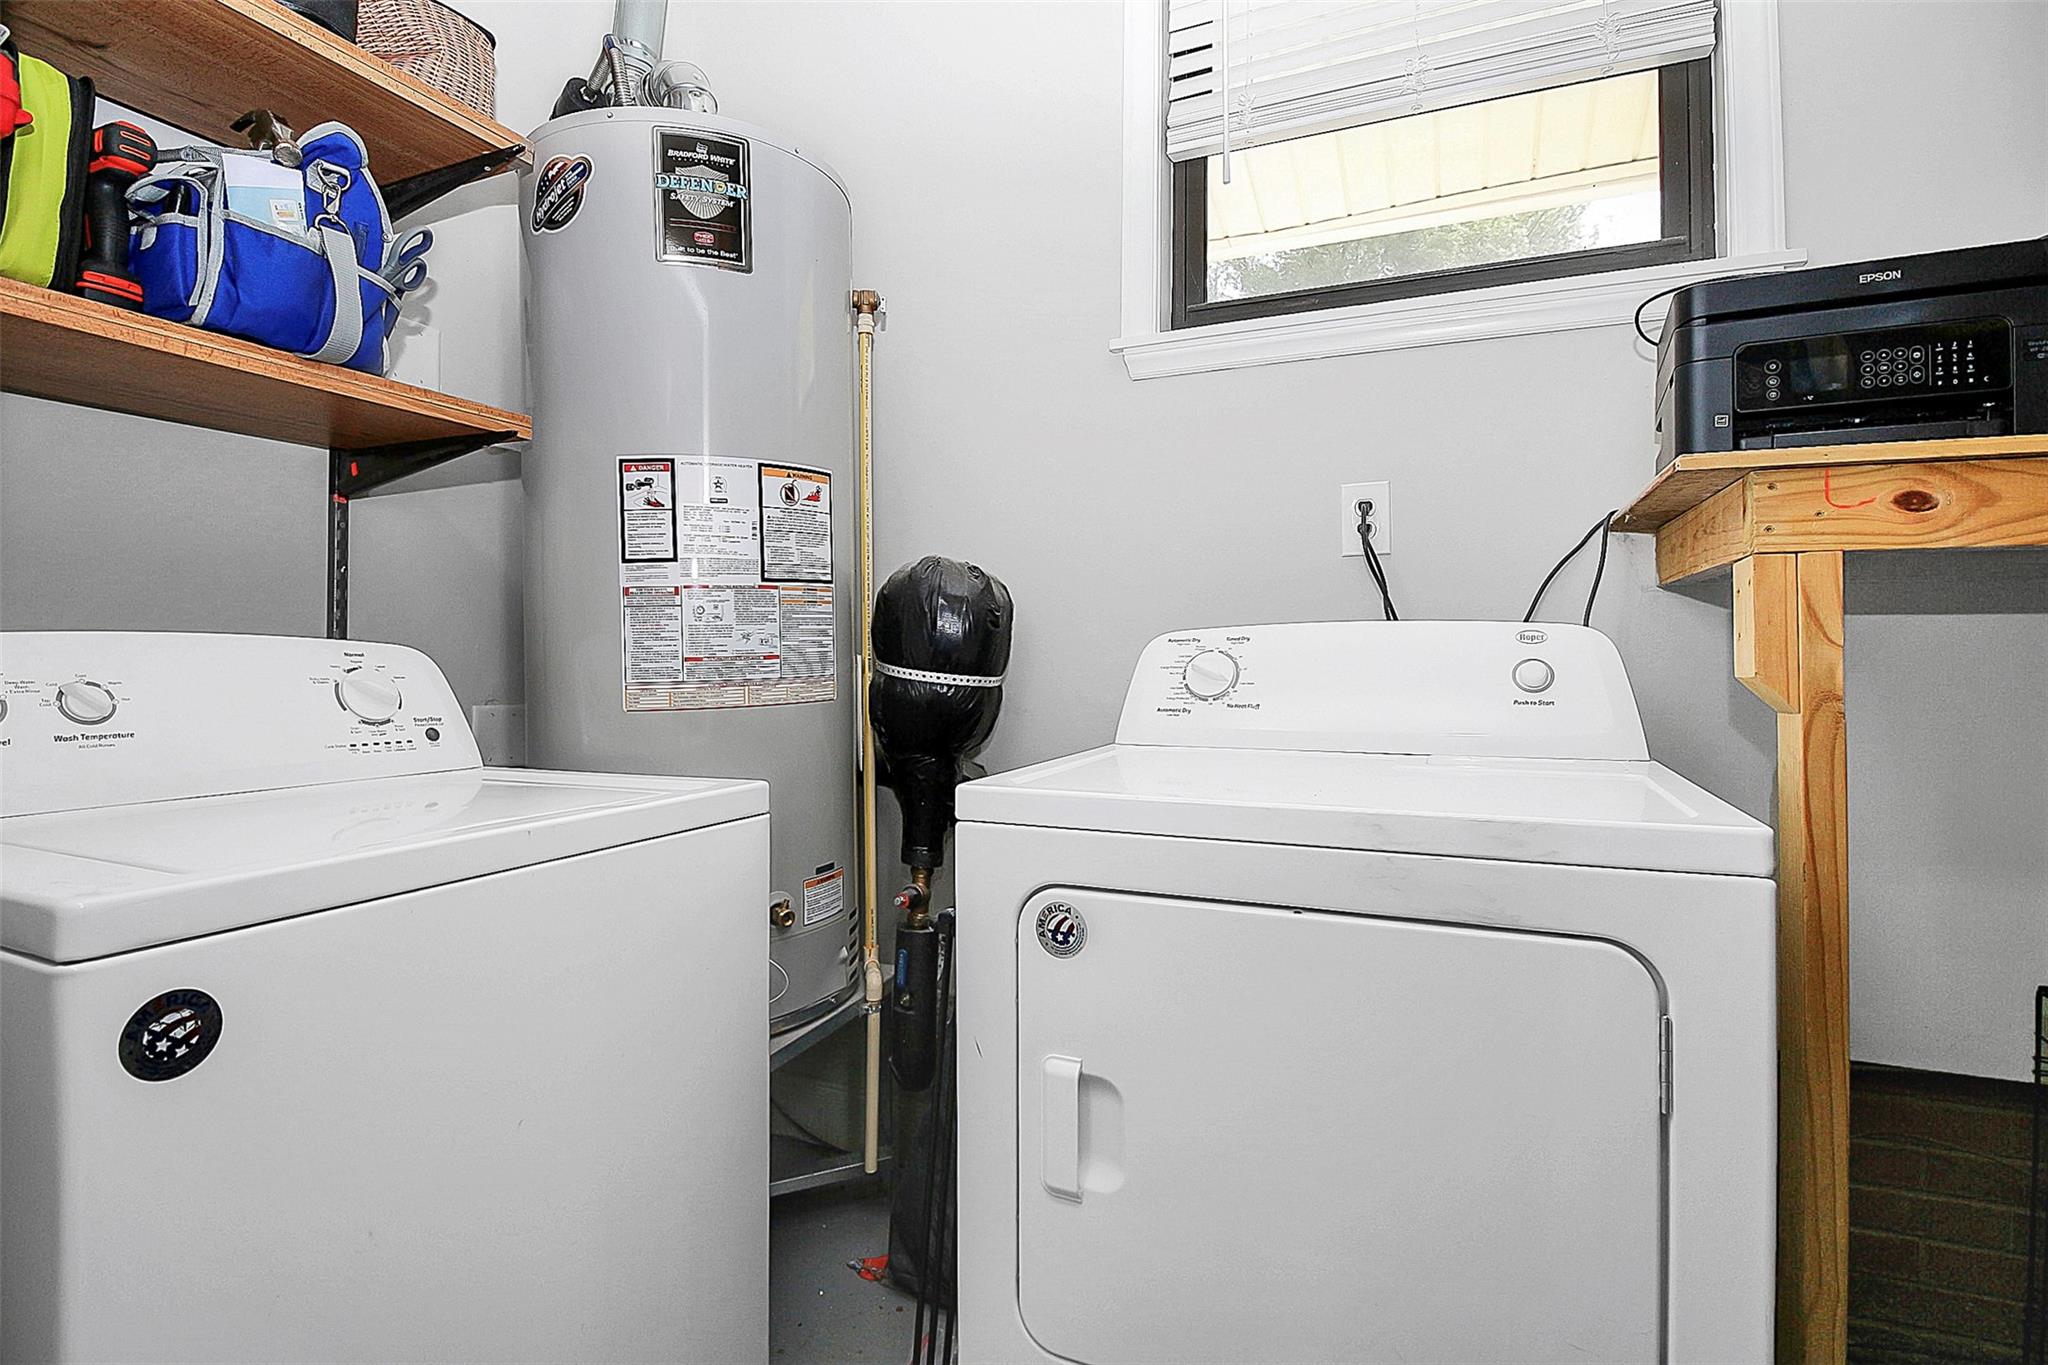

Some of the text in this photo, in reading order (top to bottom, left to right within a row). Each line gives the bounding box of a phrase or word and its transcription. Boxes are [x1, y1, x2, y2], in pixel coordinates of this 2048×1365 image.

[667, 149, 709, 160] BRADFORD
[710, 155, 736, 165] WHITE
[656, 173, 748, 200] DEFENDER
[1859, 270, 1901, 283] EPSON
[1519, 633, 1545, 642] Roper
[53, 732, 135, 742] Wash Temperature
[1038, 903, 1072, 938] AMERICA
